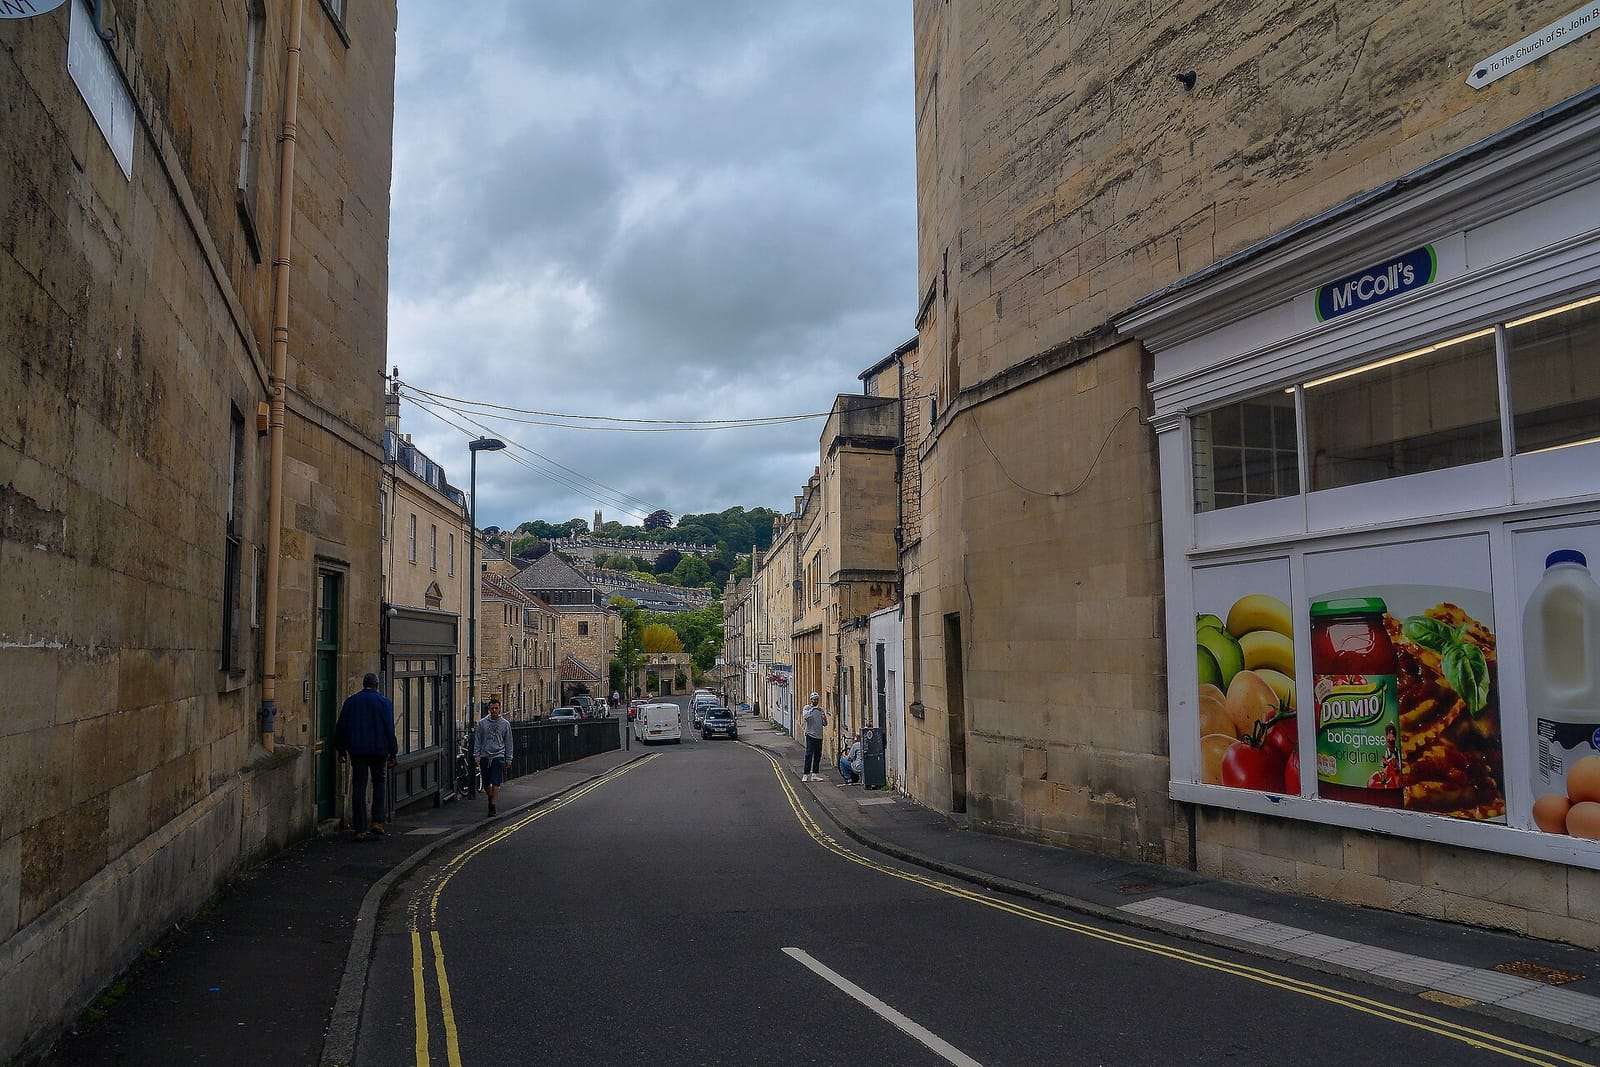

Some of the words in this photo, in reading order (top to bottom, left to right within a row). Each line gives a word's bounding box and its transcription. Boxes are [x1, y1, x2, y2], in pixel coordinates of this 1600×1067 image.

[1490, 62, 1499, 71] To
[1500, 54, 1515, 67] The
[1515, 38, 1545, 59] Church
[1546, 31, 1555, 43] of
[1556, 27, 1568, 39] St.
[1569, 14, 1591, 32] John
[1332, 262, 1415, 312] McColl's
[1322, 694, 1379, 721] DOLMIO
[1327, 728, 1387, 748] bolognese
[1335, 747, 1379, 766] original
